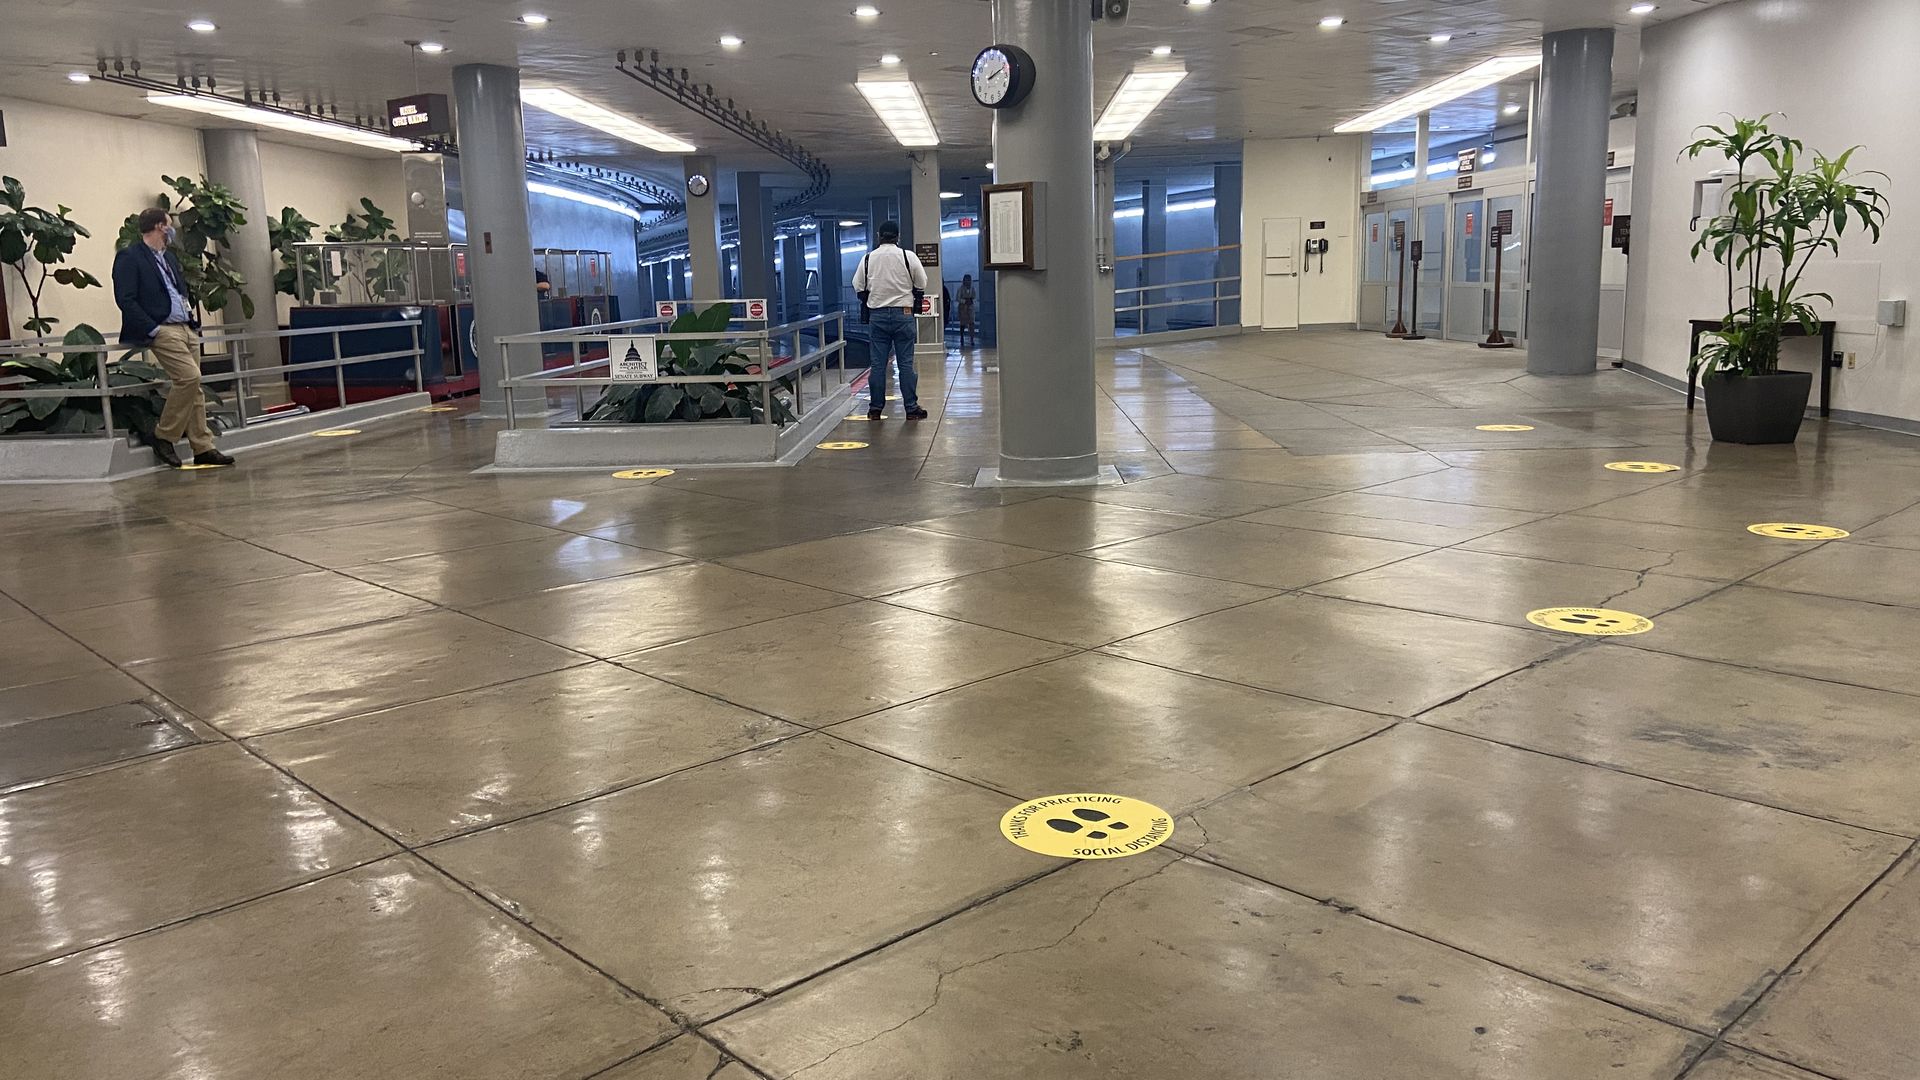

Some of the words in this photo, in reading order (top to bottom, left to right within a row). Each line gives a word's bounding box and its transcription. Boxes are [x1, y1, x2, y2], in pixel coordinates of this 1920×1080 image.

[1038, 796, 1121, 807] PRACTICING
[1018, 805, 1041, 817] FOR
[1009, 815, 1029, 839] THANKS
[1073, 846, 1127, 856] SOCIAL
[1125, 817, 1168, 851] DISTANCING
